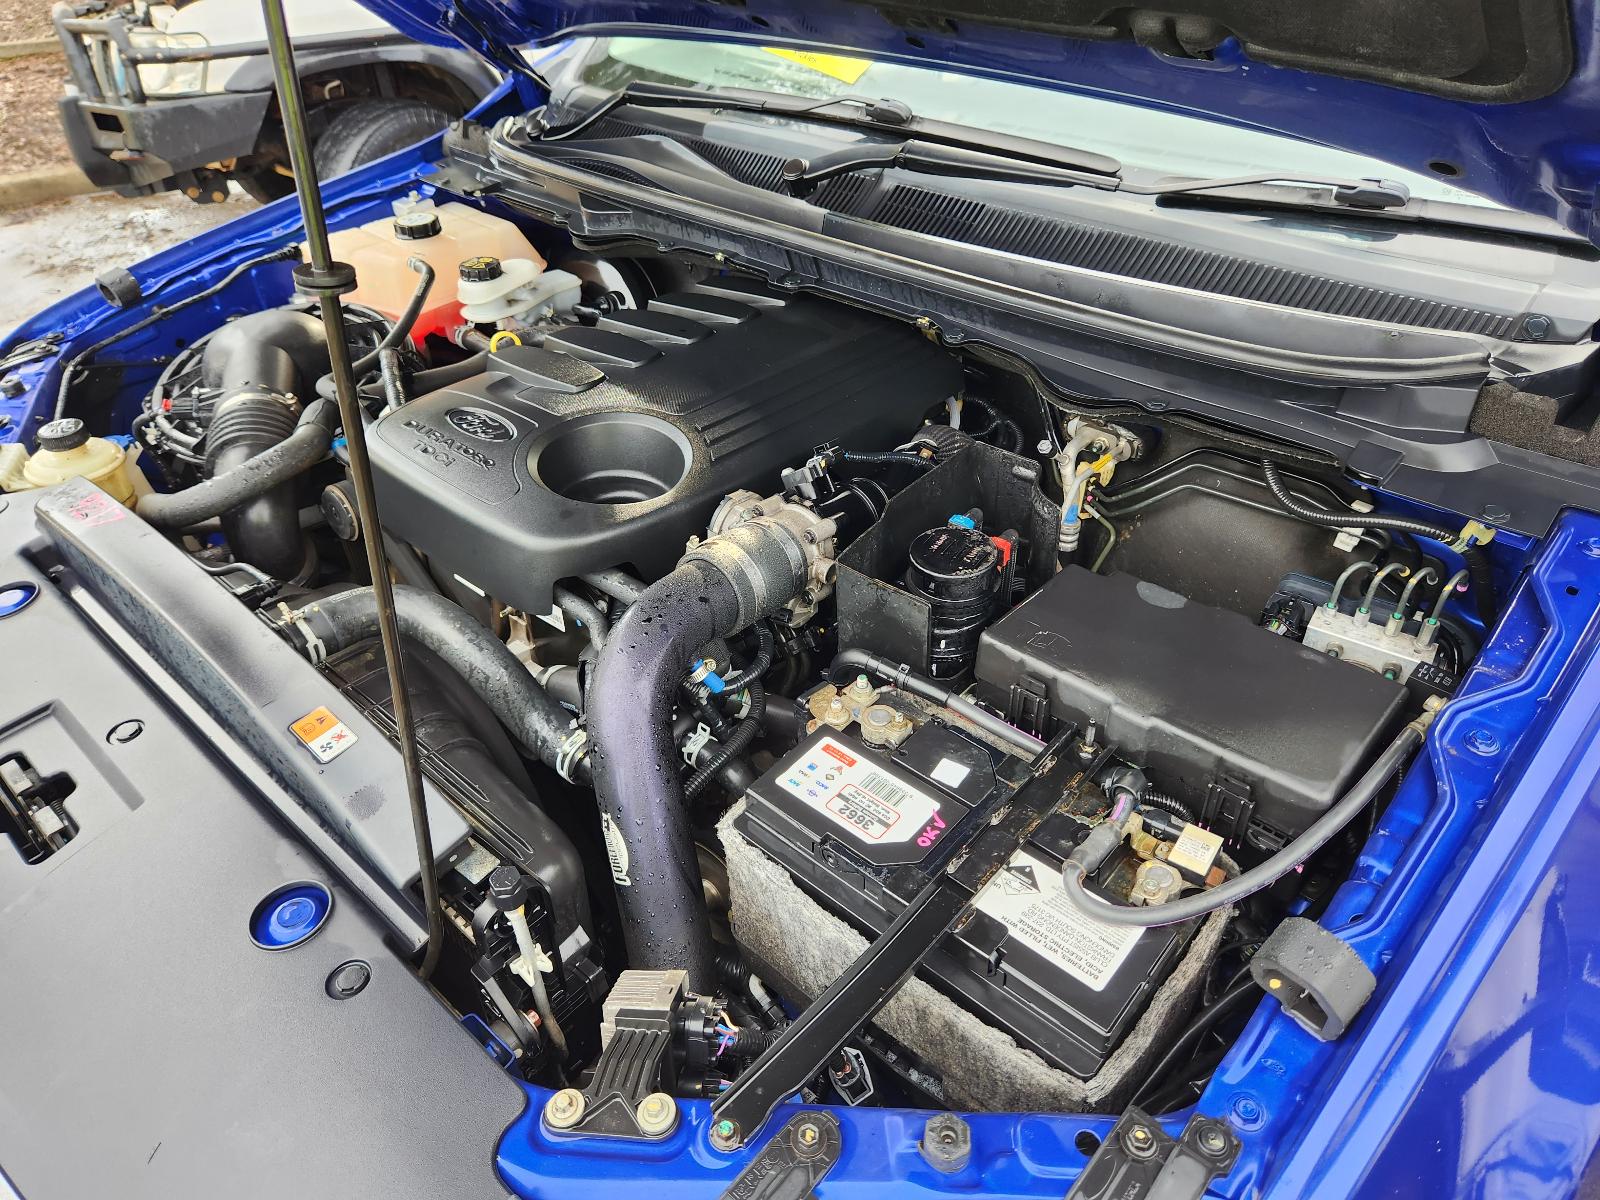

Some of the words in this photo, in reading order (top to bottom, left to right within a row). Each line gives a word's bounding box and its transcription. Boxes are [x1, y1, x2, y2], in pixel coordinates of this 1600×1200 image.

[401, 419, 497, 472] DURATORQ
[838, 803, 875, 830] 3662
[1016, 917, 1049, 940] STORAGE
[1017, 926, 1042, 944] FILLED
[1041, 940, 1059, 955] WET,
[1049, 937, 1083, 962] ELECTRIC
[1060, 952, 1099, 980] BATTERIES,
